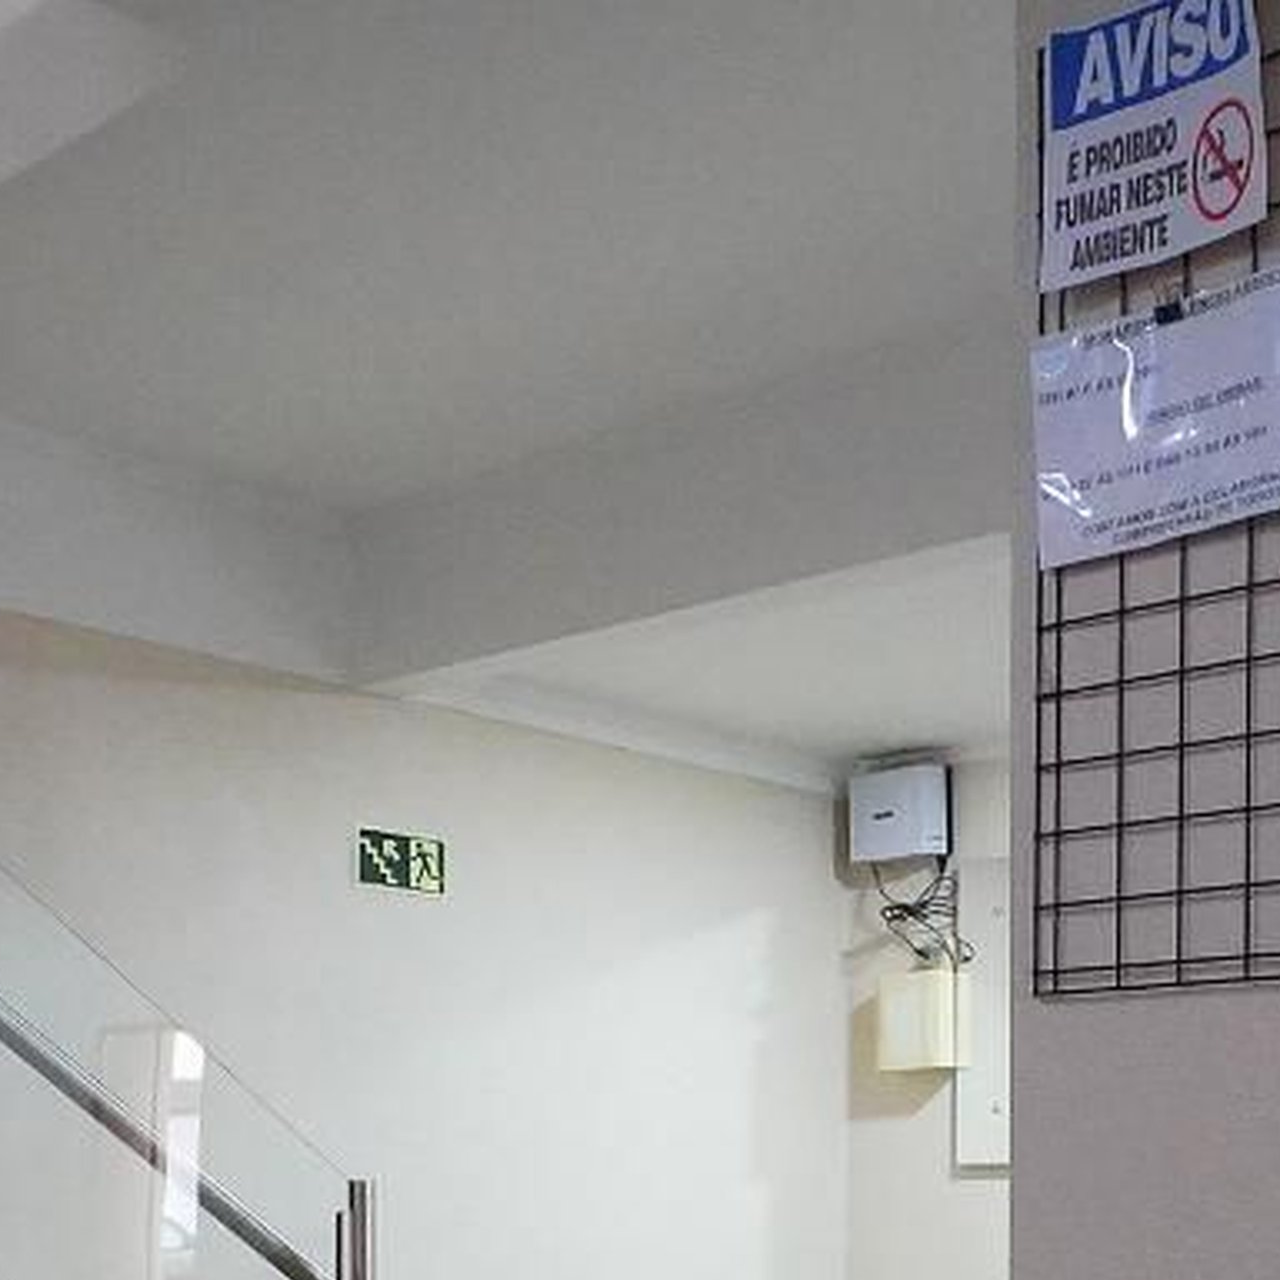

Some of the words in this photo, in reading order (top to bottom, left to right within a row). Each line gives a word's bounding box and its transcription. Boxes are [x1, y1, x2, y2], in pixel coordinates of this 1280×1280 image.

[1073, 0, 1241, 115] AVISO
[1085, 118, 1178, 178] PROIBIDO
[1055, 183, 1121, 231] FUMAR
[1126, 160, 1188, 211] NESTE
[1070, 214, 1168, 272] AMBIENTE
